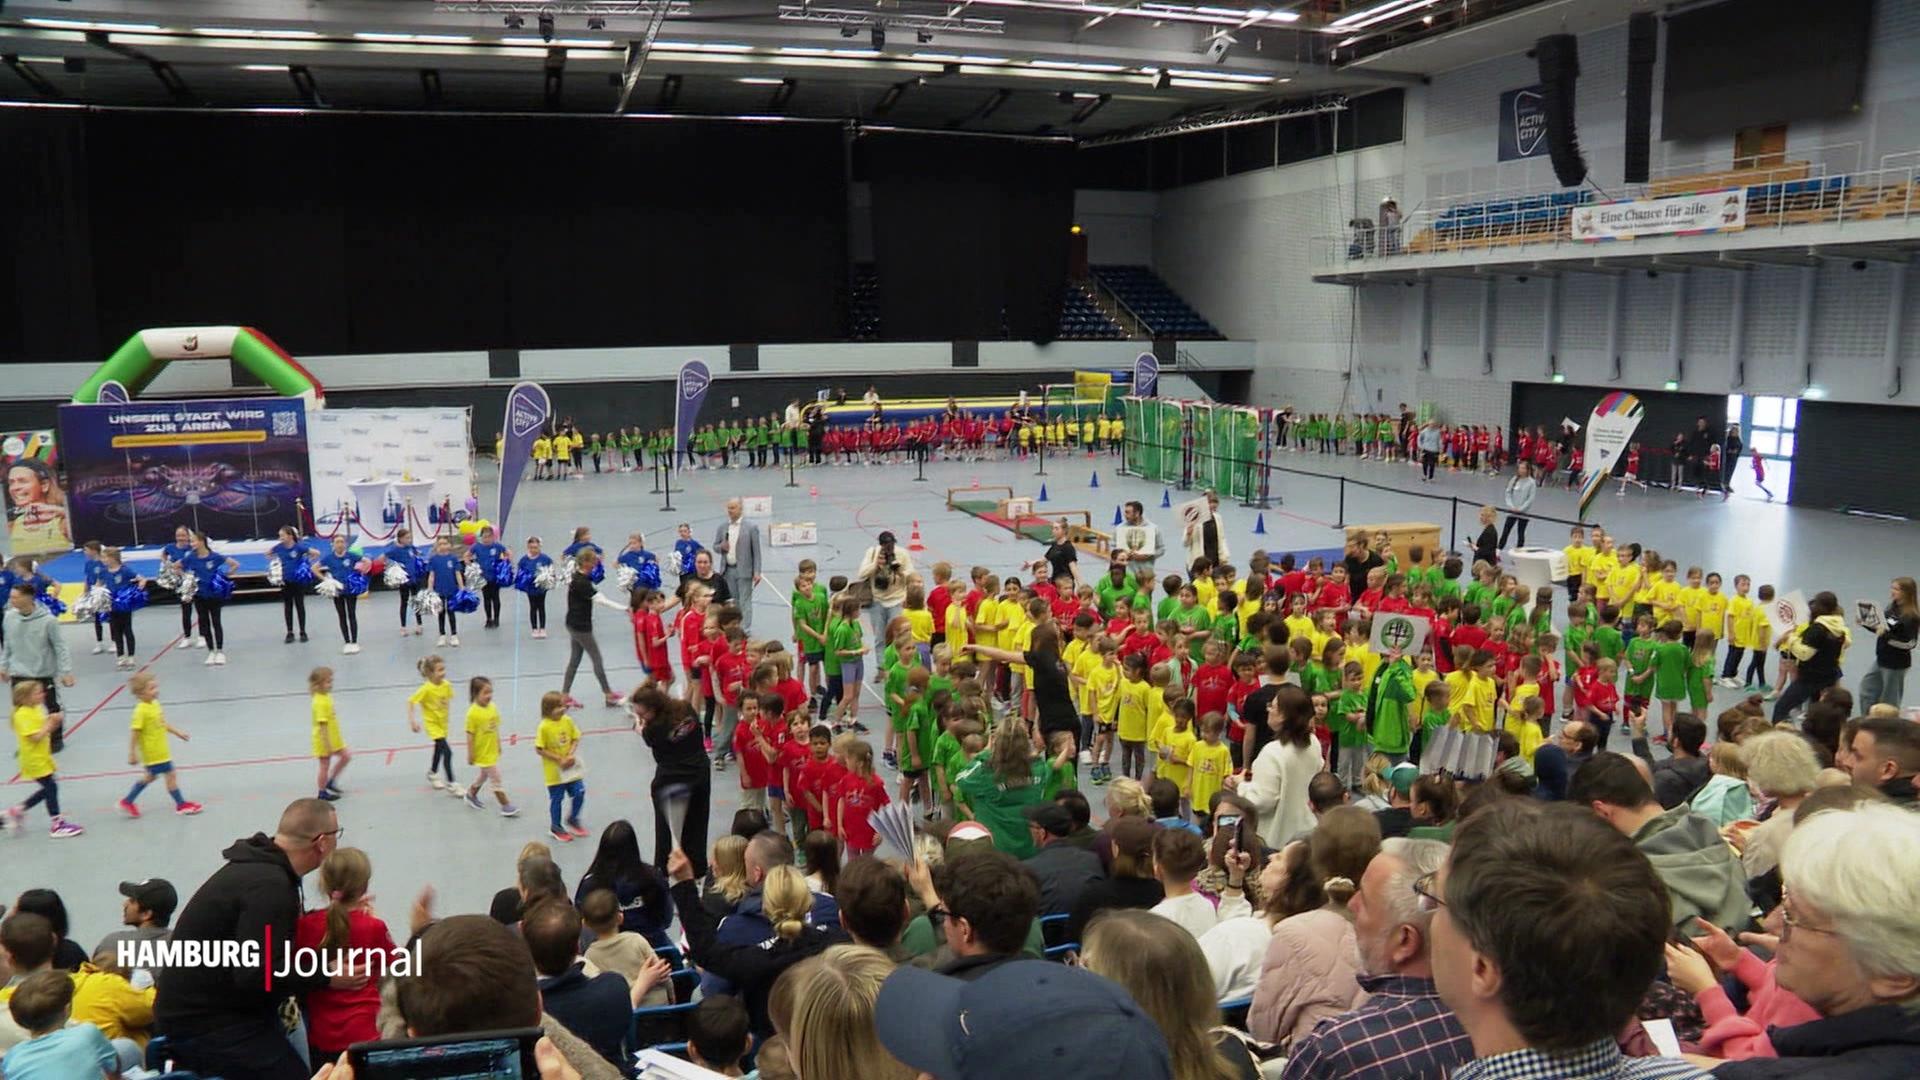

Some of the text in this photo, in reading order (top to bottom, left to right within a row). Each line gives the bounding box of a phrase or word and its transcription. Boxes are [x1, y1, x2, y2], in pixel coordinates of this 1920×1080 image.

[1519, 113, 1545, 127] ACTIV
[1520, 127, 1540, 140] CITY
[1600, 211, 1623, 224] Eine
[1625, 208, 1662, 221] Chance
[1665, 204, 1683, 218] für
[108, 410, 265, 424] UNSERE STADT WIRD
[144, 420, 232, 433] ZUR ARENA
